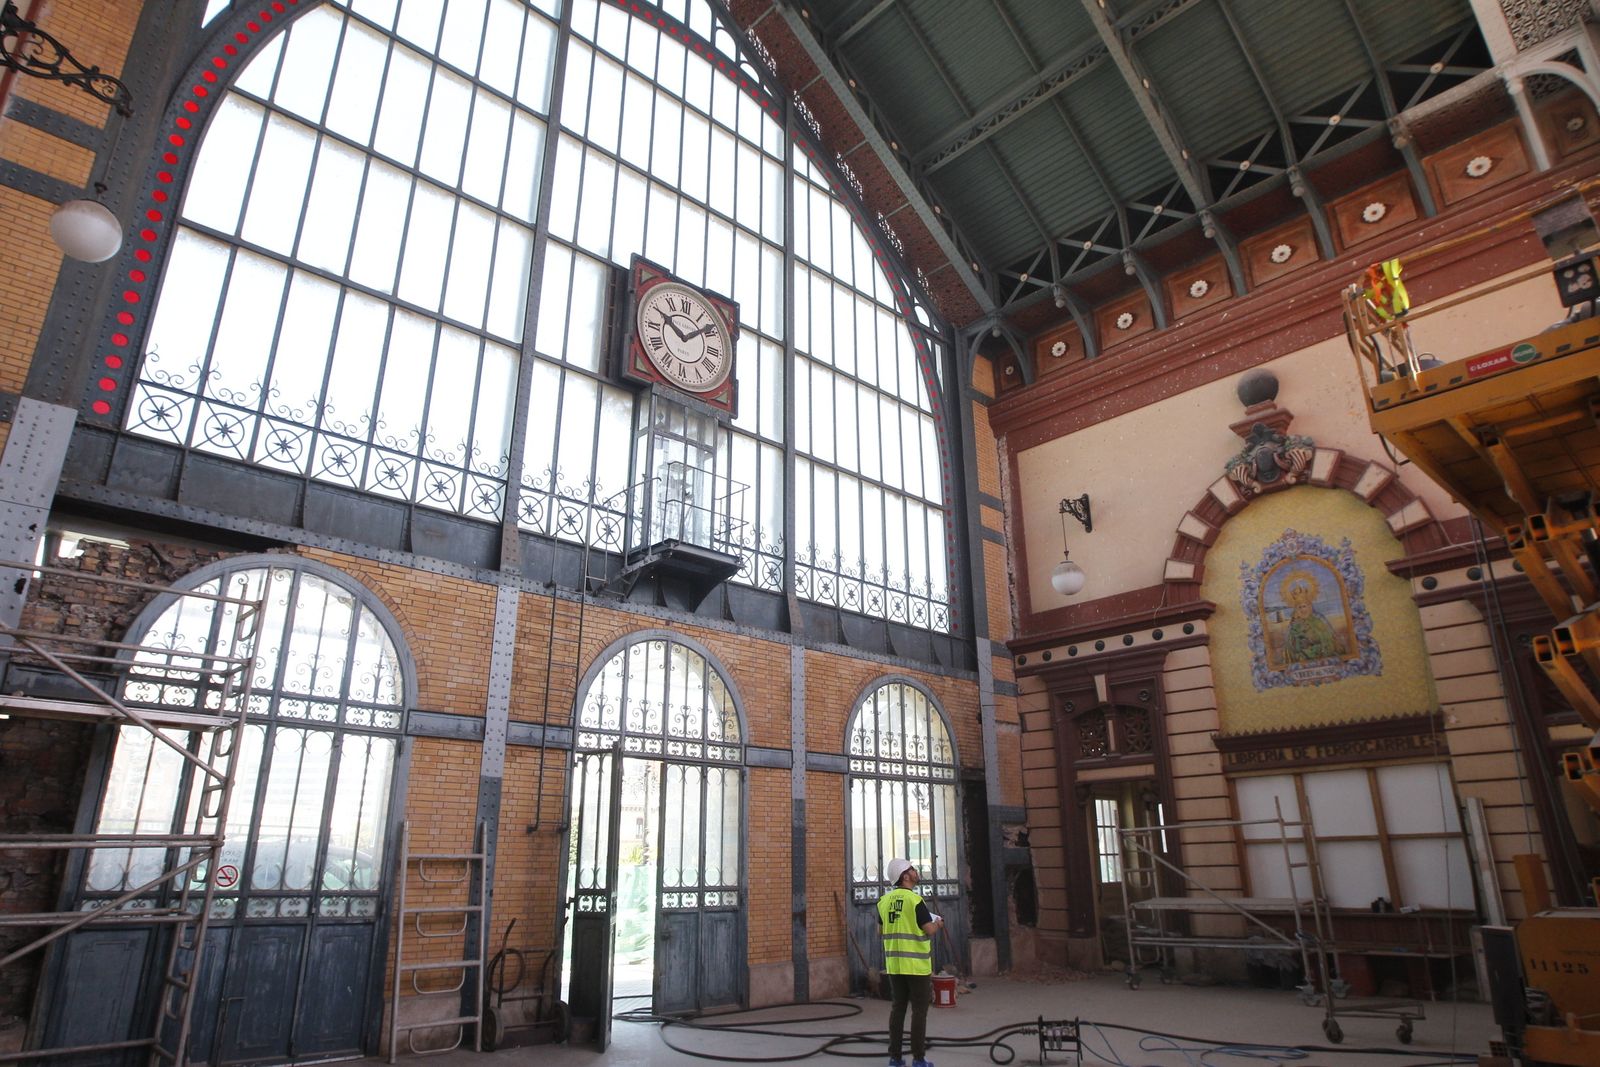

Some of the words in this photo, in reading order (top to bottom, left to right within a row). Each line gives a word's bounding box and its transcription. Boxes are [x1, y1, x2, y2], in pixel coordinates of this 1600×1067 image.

[665, 297, 677, 312] XI
[680, 299, 692, 316] XII
[707, 345, 719, 358] III
[1292, 745, 1308, 760] DE
[1317, 736, 1442, 758] FERROCARRILES
[1531, 958, 1589, 974] 11125
